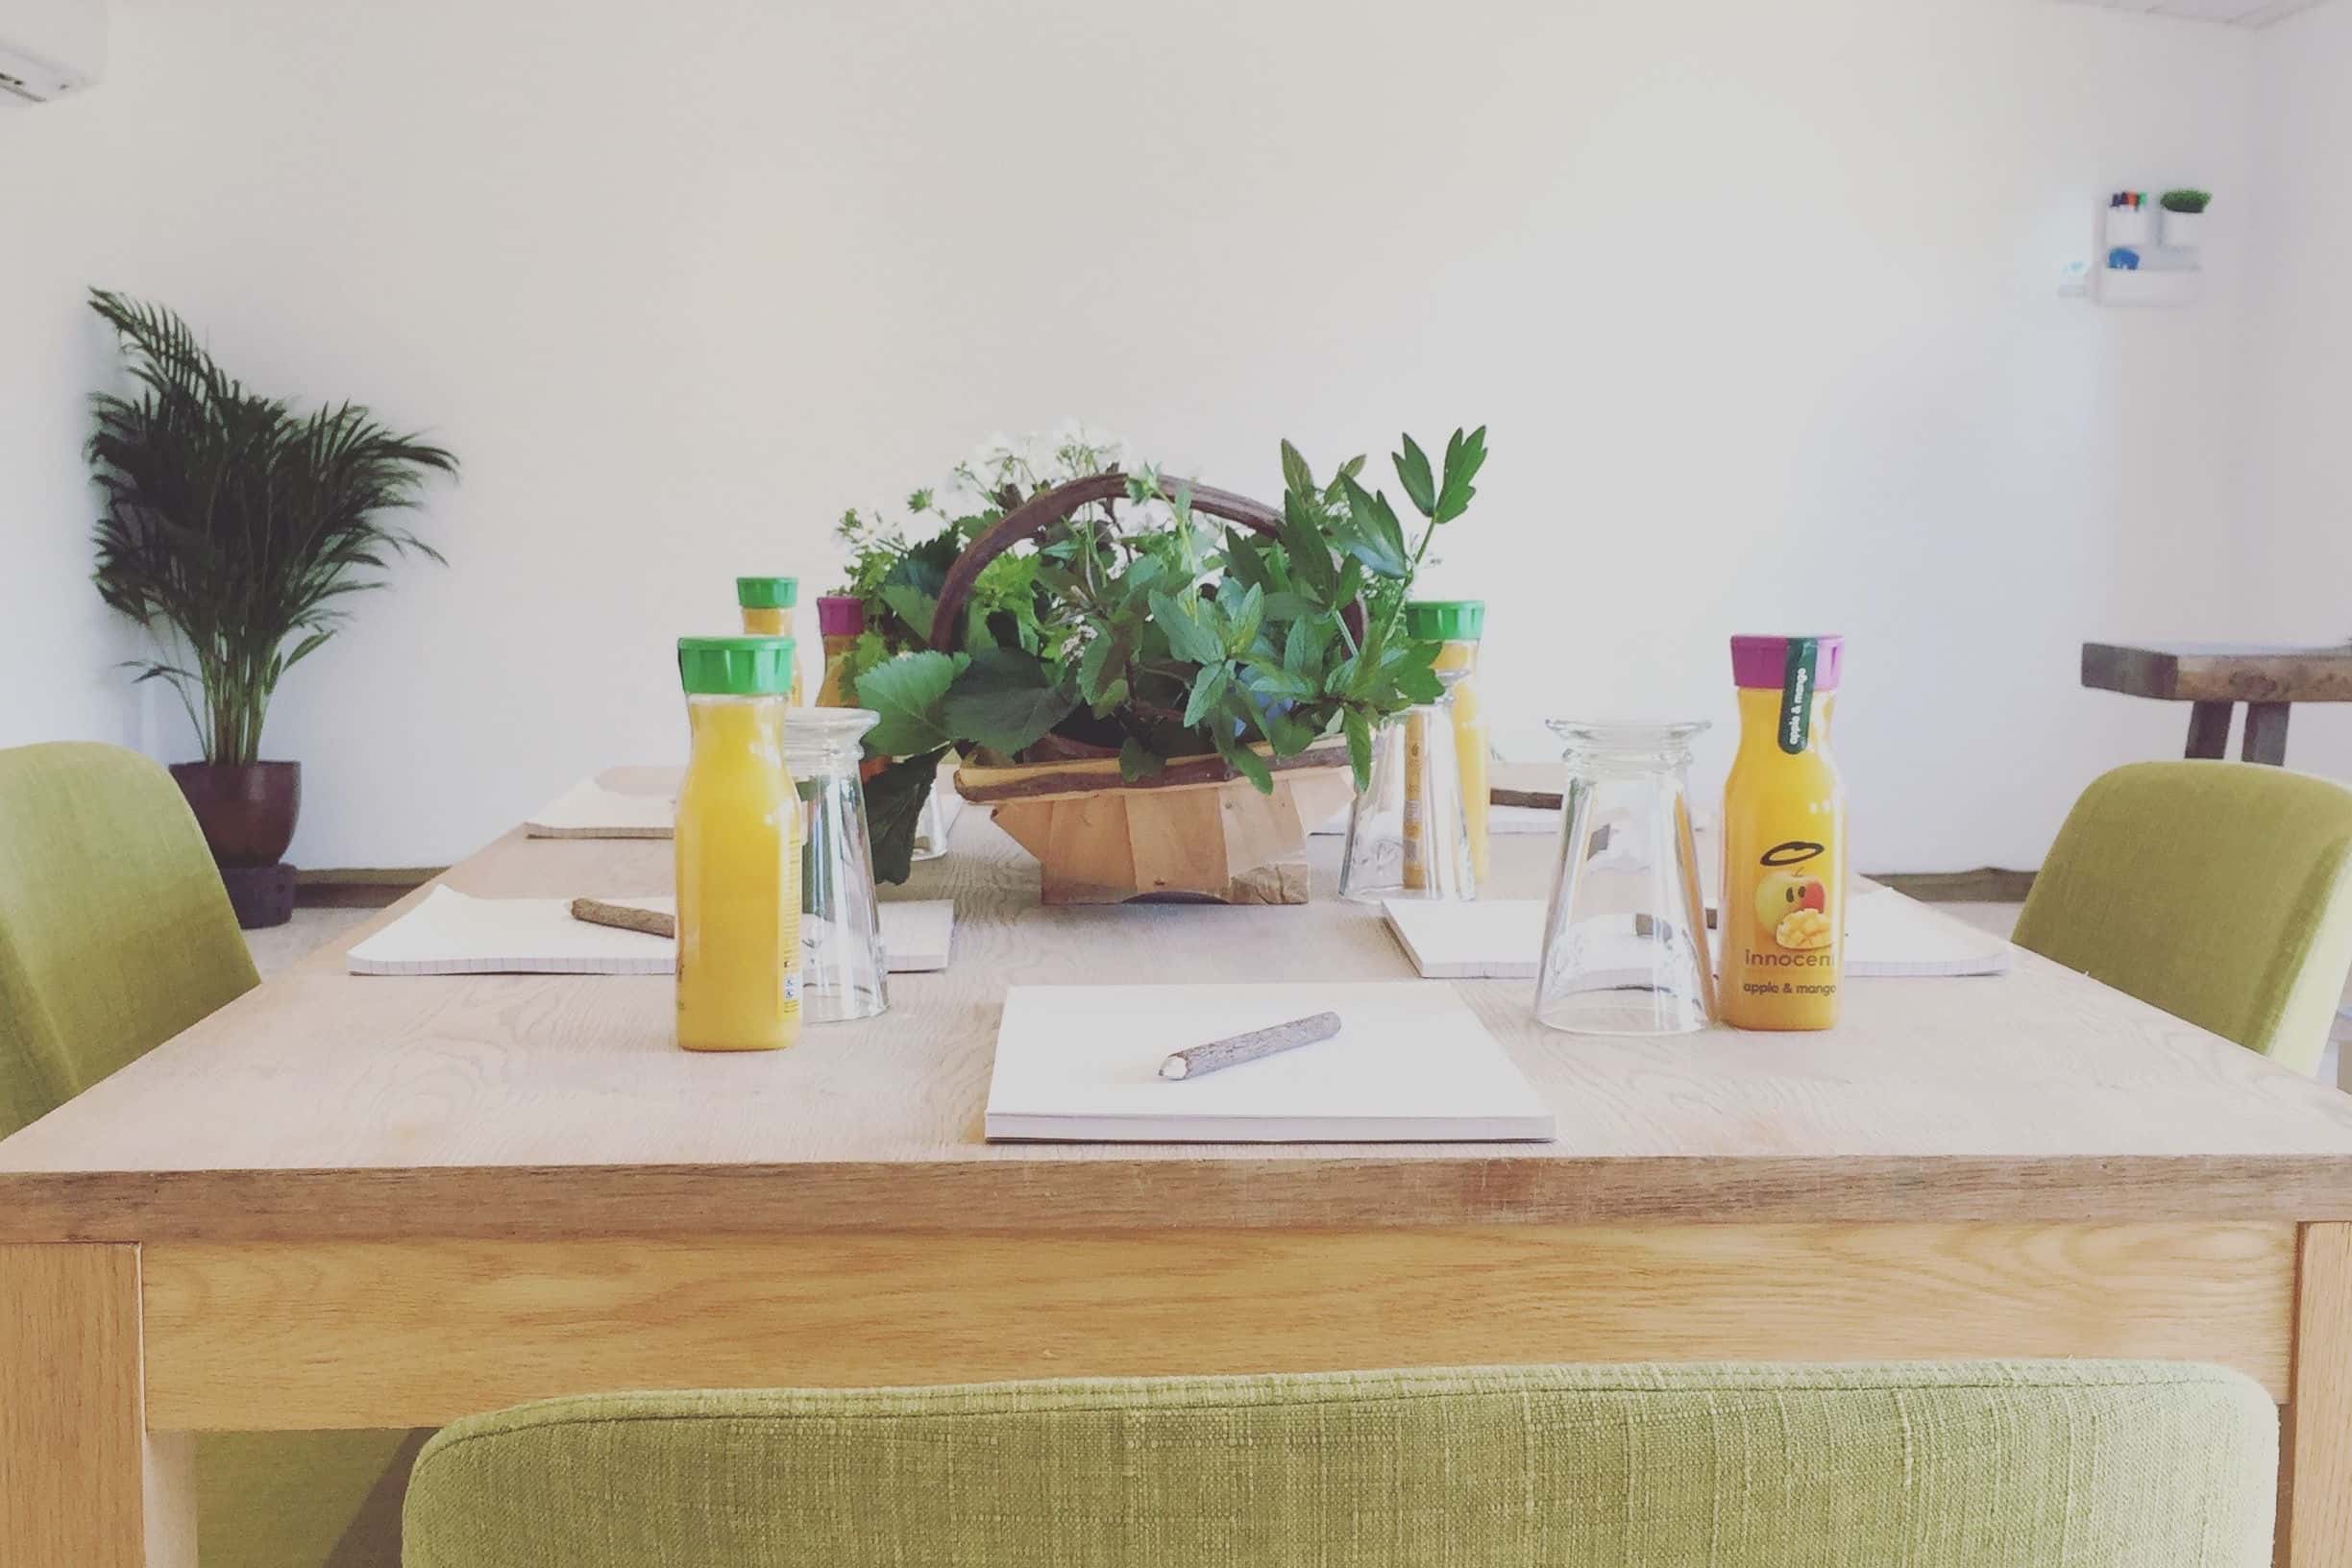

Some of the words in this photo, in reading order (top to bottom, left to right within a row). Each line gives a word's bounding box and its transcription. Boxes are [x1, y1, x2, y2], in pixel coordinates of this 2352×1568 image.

[1794, 667, 1807, 703] mango
[1790, 704, 1801, 714] &
[1789, 715, 1801, 745] apple
[1743, 980, 1779, 994] apple
[1782, 982, 1793, 993] &
[1796, 983, 1836, 995] mango
